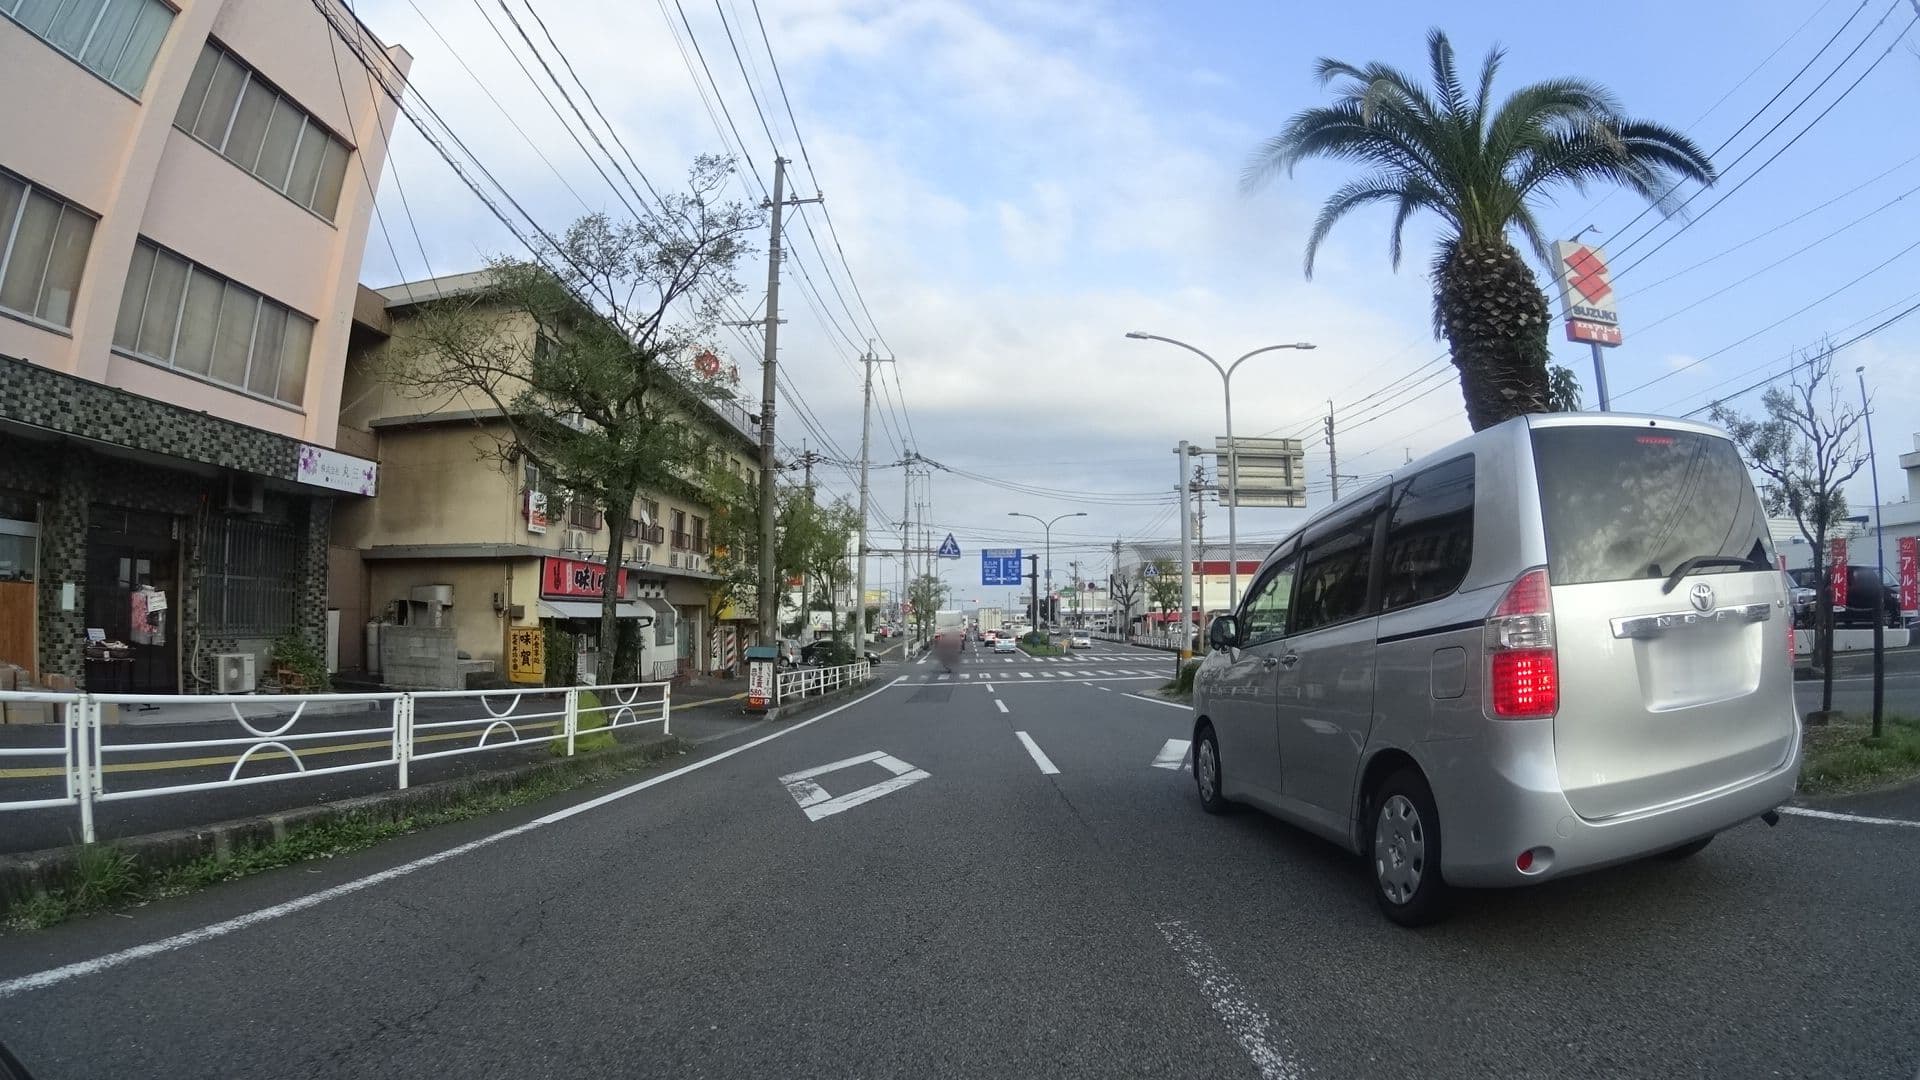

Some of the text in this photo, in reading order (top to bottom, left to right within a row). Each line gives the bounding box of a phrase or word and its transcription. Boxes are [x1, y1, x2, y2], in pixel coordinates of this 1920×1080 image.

[1573, 306, 1617, 321] SUZUKI
[1833, 556, 1844, 602] アルト
[1902, 556, 1913, 607] アルト
